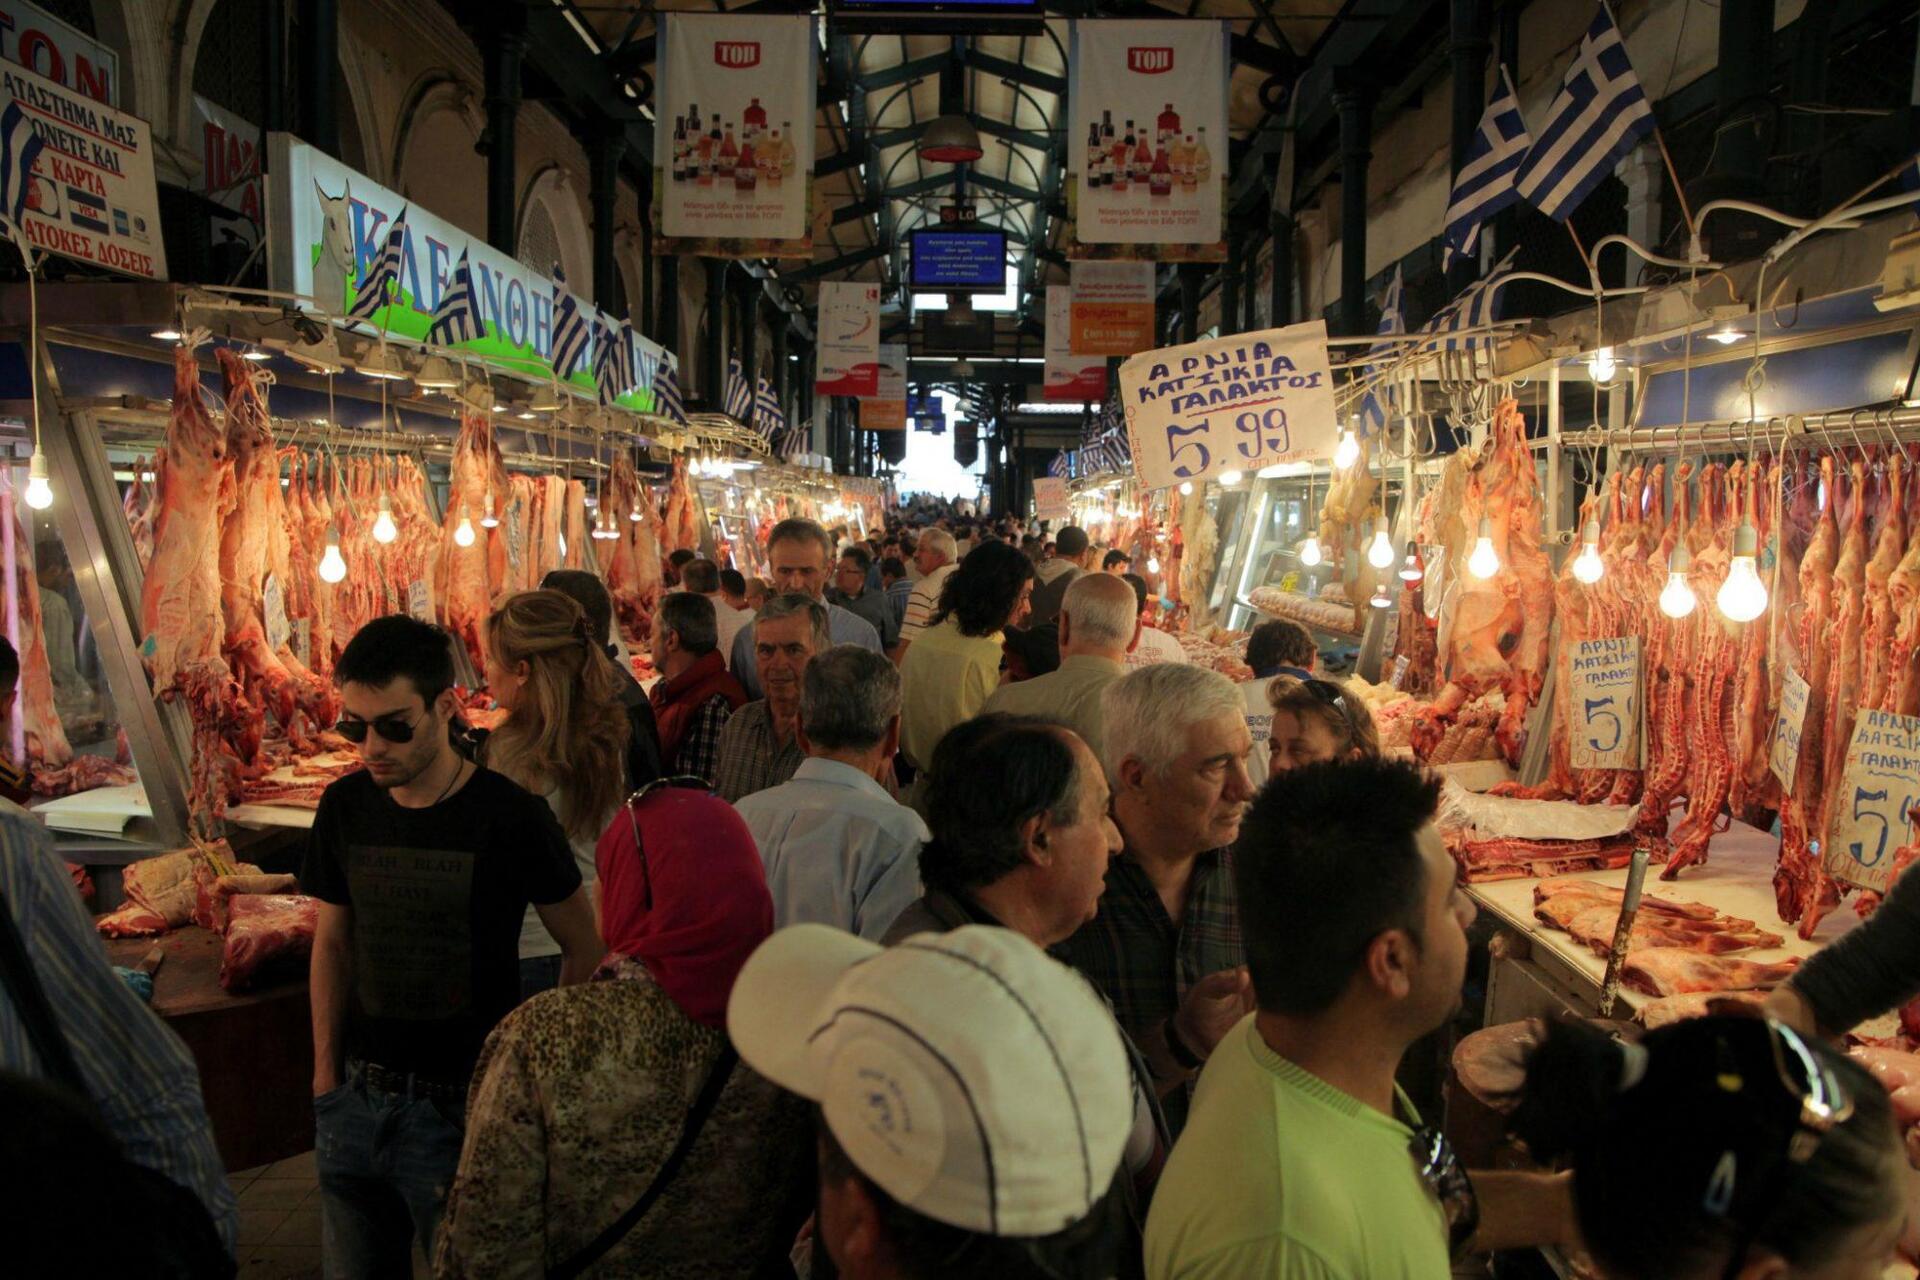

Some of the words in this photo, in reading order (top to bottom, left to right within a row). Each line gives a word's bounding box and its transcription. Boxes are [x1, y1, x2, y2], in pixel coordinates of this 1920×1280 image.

[4, 71, 99, 134] ΑΤΑΣΤΗΜΑ
[102, 116, 138, 150] ΜΑΣ
[32, 117, 90, 164] ΩΝΕΤΕ
[92, 143, 120, 173] ΚΑΙ
[51, 156, 107, 197] ΚΑΡΤΑ
[78, 203, 98, 220] VISA
[959, 211, 974, 221] LG
[25, 217, 94, 259] ΑΤΟΚΕΣ
[98, 241, 154, 277] ΔΟΣΕΙΣ
[1138, 356, 1296, 403] ΚΑΤΣΙΚΙΑ
[1149, 342, 1272, 380] ΑΡΝΙΑ
[1171, 371, 1322, 414] ΓΑΛΑΚΤΟΣ
[1585, 667, 1634, 684] ΓΑΛΑΚΤ
